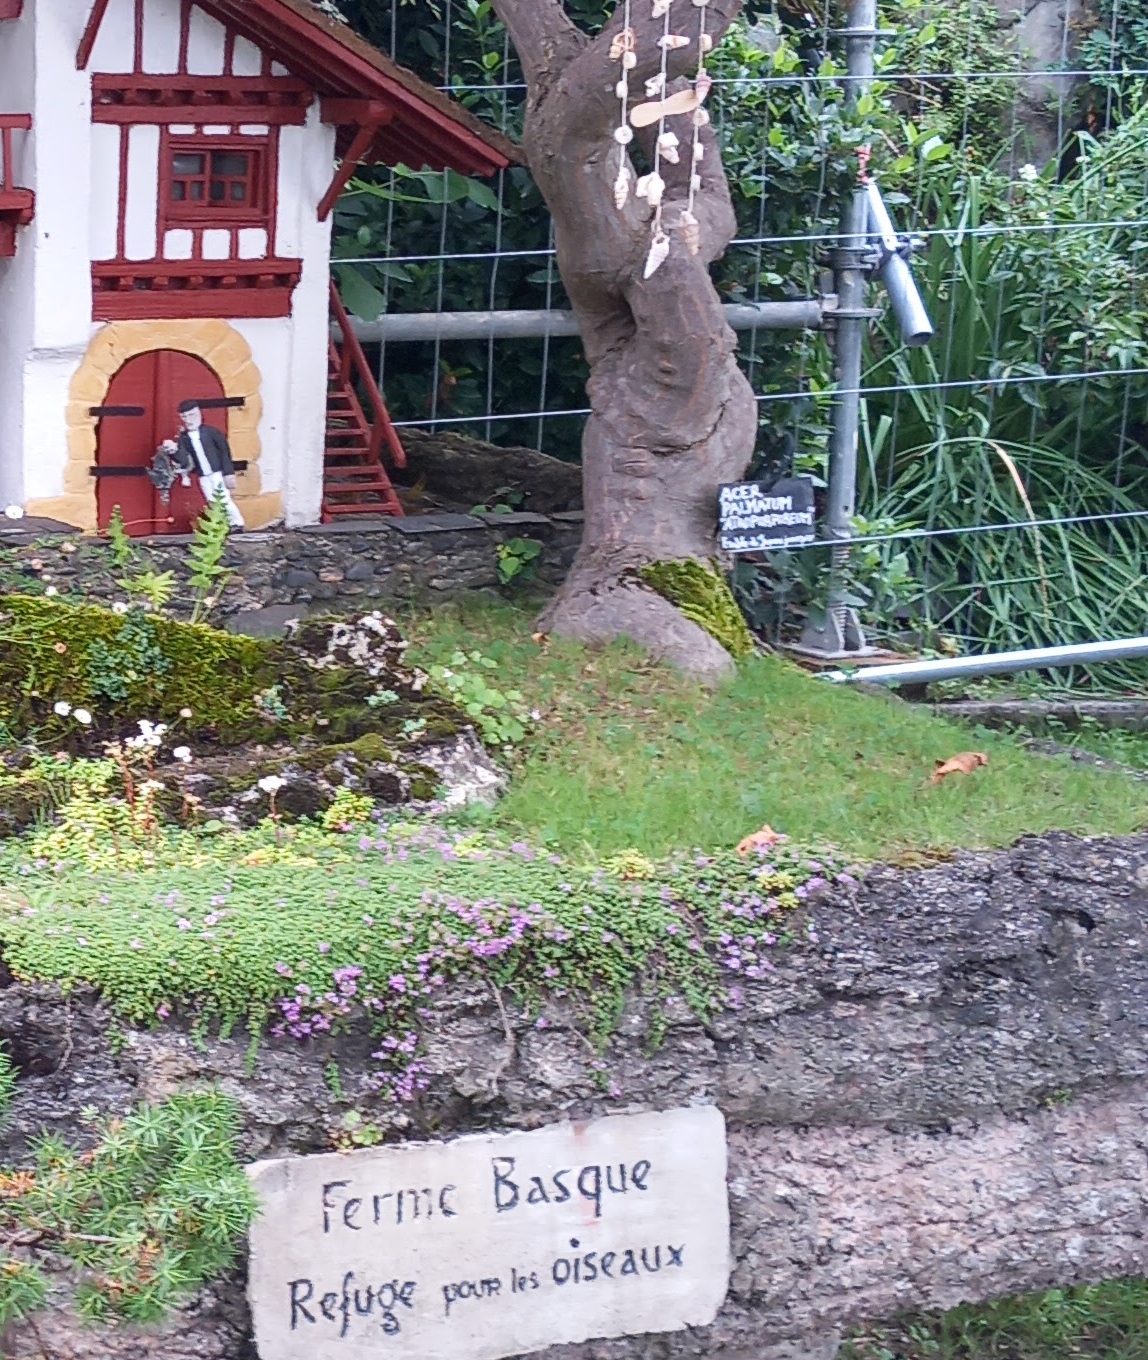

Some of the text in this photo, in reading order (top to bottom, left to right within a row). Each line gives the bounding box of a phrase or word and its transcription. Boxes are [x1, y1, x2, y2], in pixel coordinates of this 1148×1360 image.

[719, 484, 763, 502] ACER
[721, 496, 792, 517] PALMATUM
[322, 1156, 651, 1233] Ferme Basque
[287, 1271, 417, 1338] Refuge
[442, 1277, 502, 1317] pour
[510, 1267, 540, 1293] les
